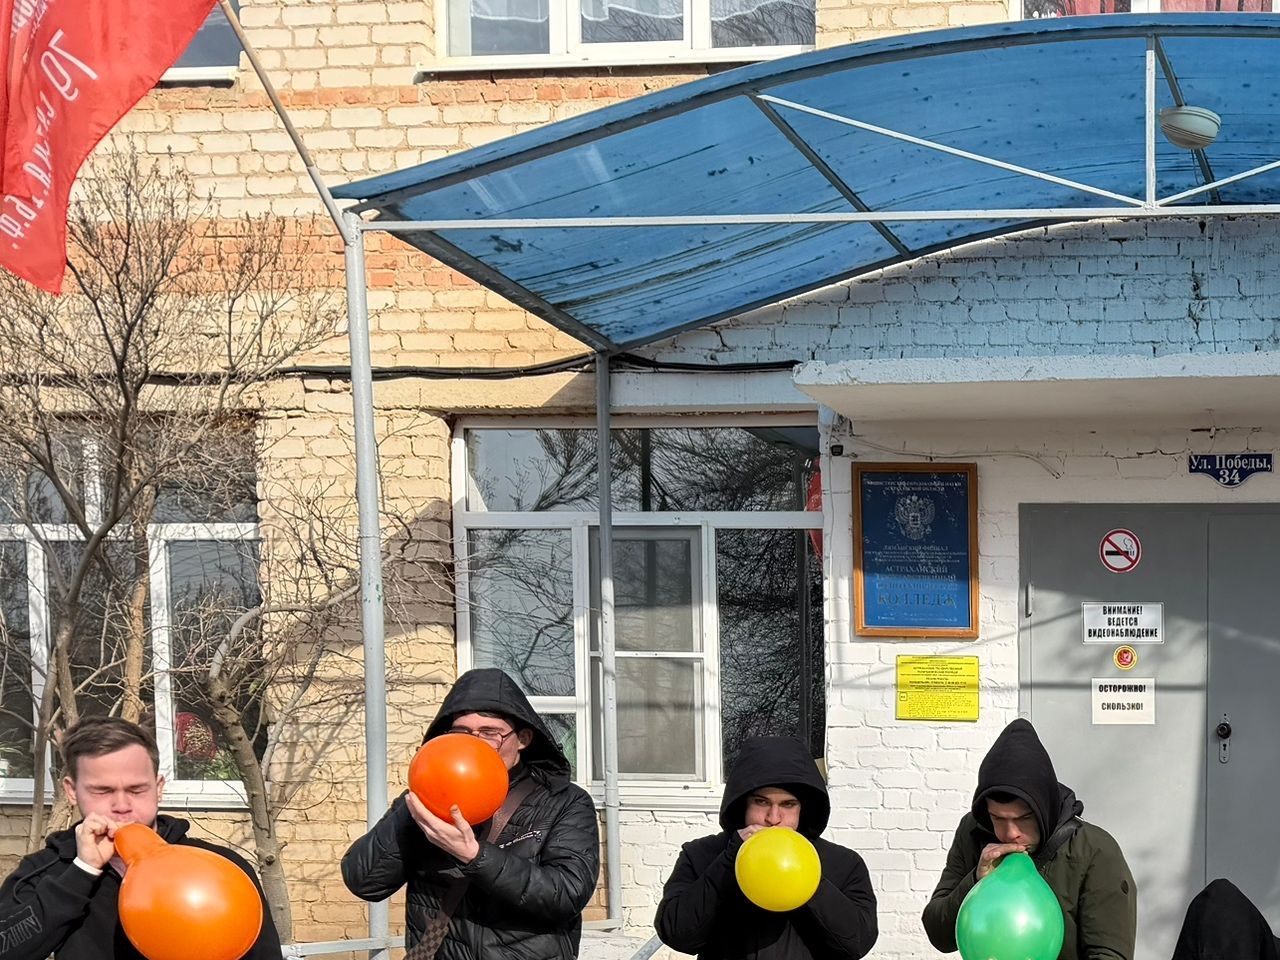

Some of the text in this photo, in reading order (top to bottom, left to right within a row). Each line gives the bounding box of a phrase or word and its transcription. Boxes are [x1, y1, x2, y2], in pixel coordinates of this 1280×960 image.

[1190, 454, 1272, 471] Ул. Победы,
[1219, 469, 1240, 484] 34
[1102, 605, 1143, 615] ВНИМАНИЕ!
[1107, 616, 1138, 627] ВЕДЕТСЯ
[1087, 627, 1158, 639] ВИДЕОНАБЛЮДЕНИЕ
[1098, 684, 1147, 693] ОСТОРОЖНО!
[1101, 702, 1144, 711] СКОЛЬЗКО!
